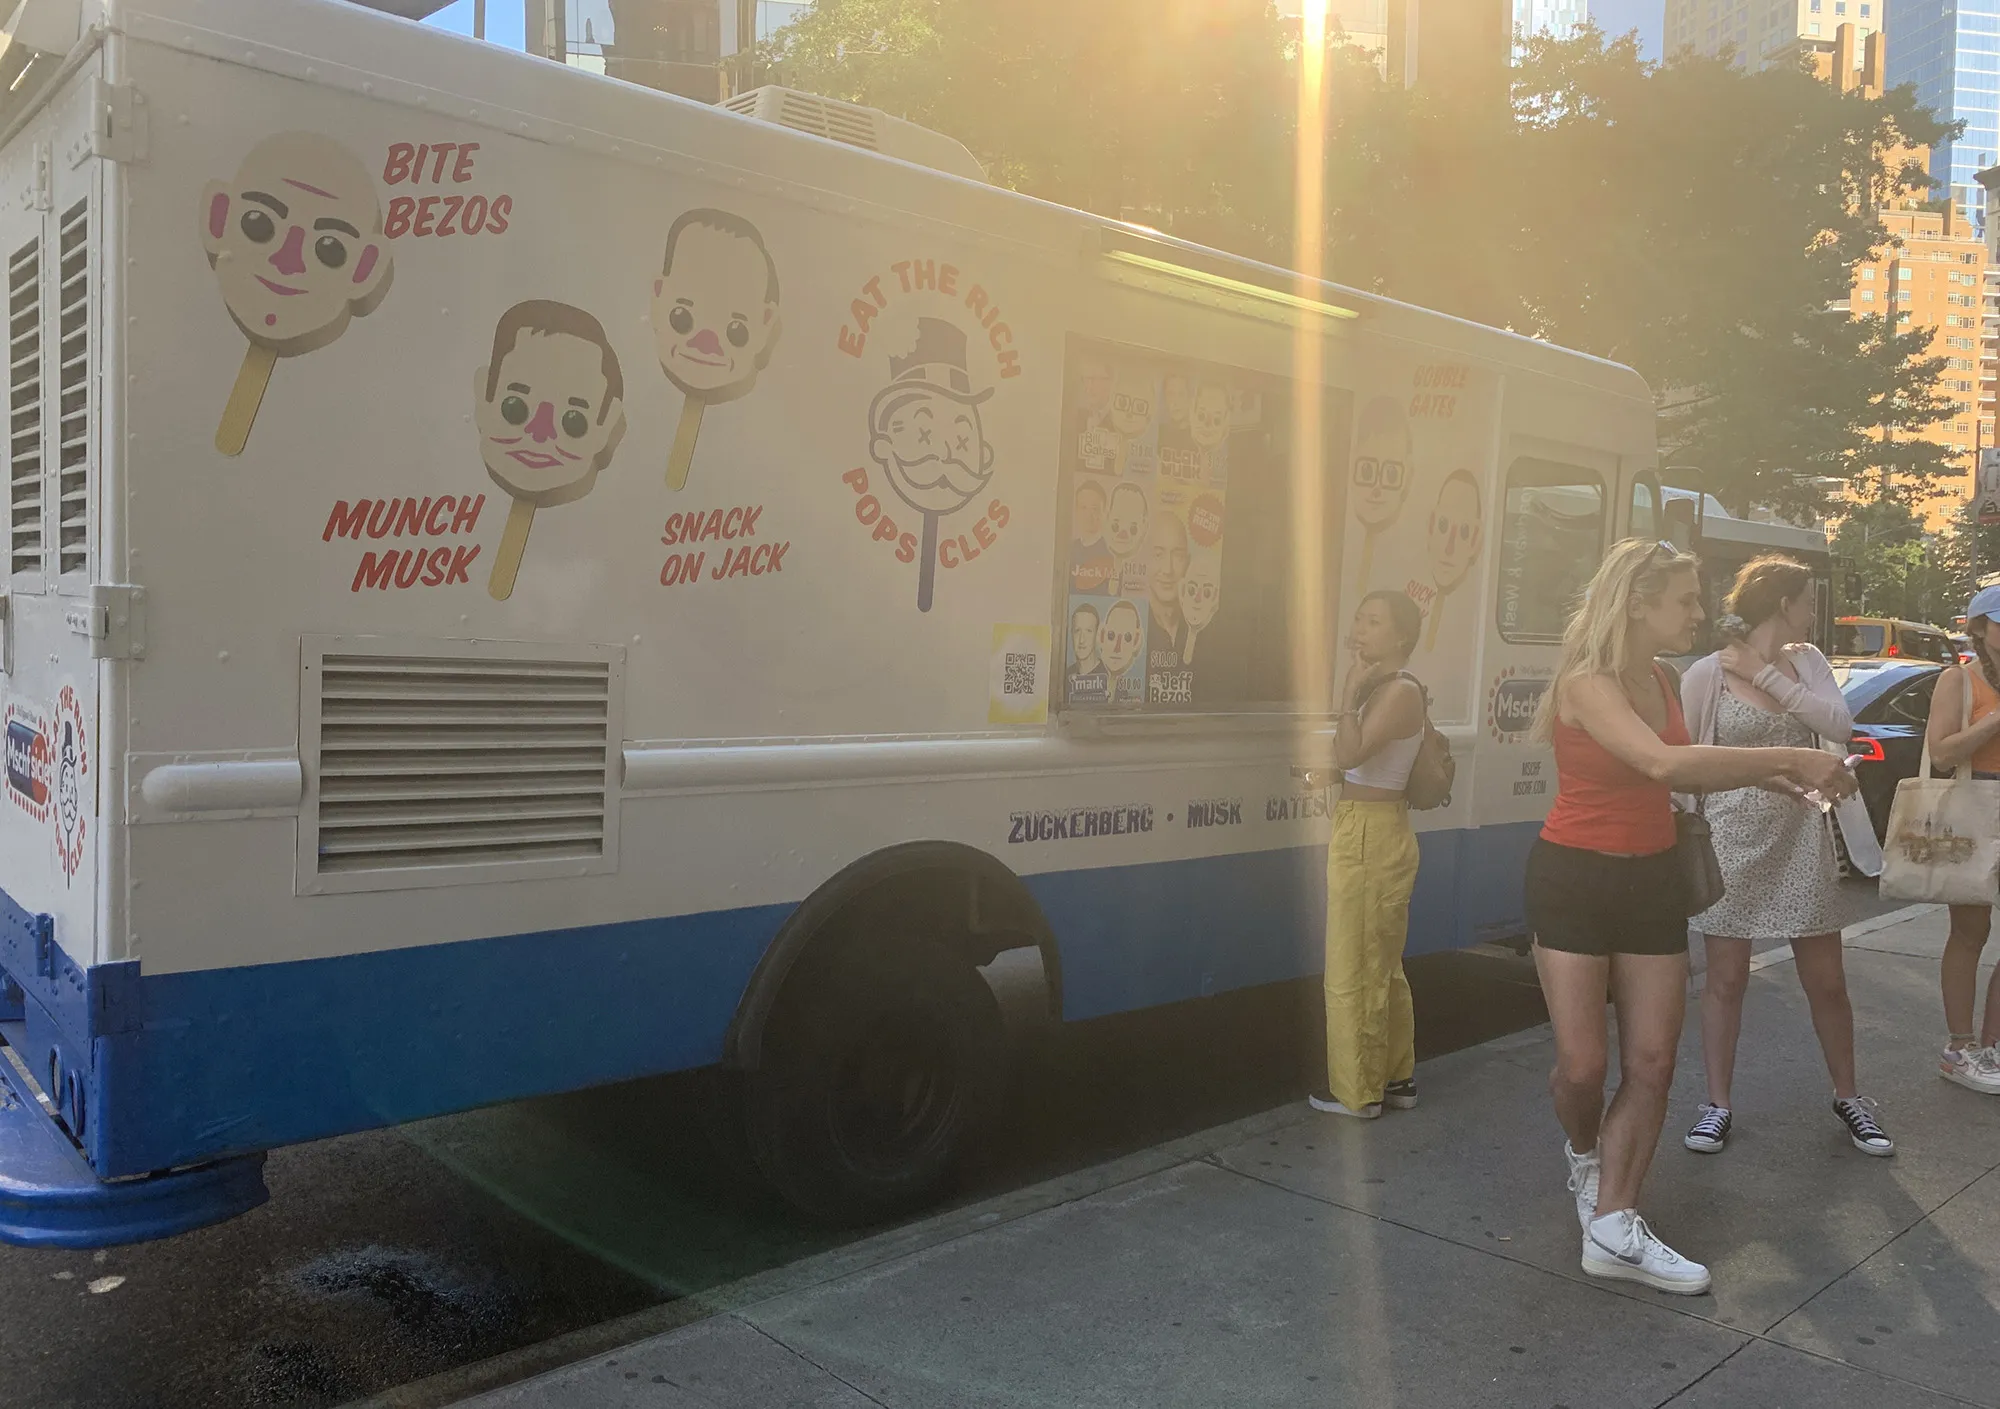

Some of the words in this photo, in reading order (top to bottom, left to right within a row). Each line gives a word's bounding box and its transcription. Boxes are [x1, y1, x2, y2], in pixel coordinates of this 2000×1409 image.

[383, 142, 480, 185] BITE
[384, 194, 513, 240] BEZOS
[837, 275, 888, 358] EAT
[890, 258, 960, 297] THE
[965, 284, 1021, 379] RICH
[1412, 364, 1470, 389] GOBBLE
[1409, 394, 1457, 418] GATES
[1084, 443, 1115, 458] Gates
[322, 494, 486, 542] MUNCH
[660, 505, 763, 546] SNACK
[352, 545, 481, 592] MUSK
[659, 552, 706, 587] ON
[712, 541, 791, 580] JACK
[1071, 564, 1103, 578] Jack
[1123, 562, 1147, 577] $10.00
[1405, 579, 1437, 605] SUCK
[1150, 650, 1178, 668] $10.00
[1074, 676, 1103, 690] mark
[1119, 677, 1142, 691] $10.00
[1161, 672, 1193, 690] Jeff
[1151, 687, 1192, 703] Bezos
[1498, 692, 1537, 718] Msch
[52, 702, 61, 763] EAT
[60, 685, 73, 712] THE
[74, 698, 87, 775] RICH
[1008, 804, 1154, 844] ZUCKERBERG
[1187, 797, 1242, 828] MUSK
[1266, 791, 1325, 821] GATES
